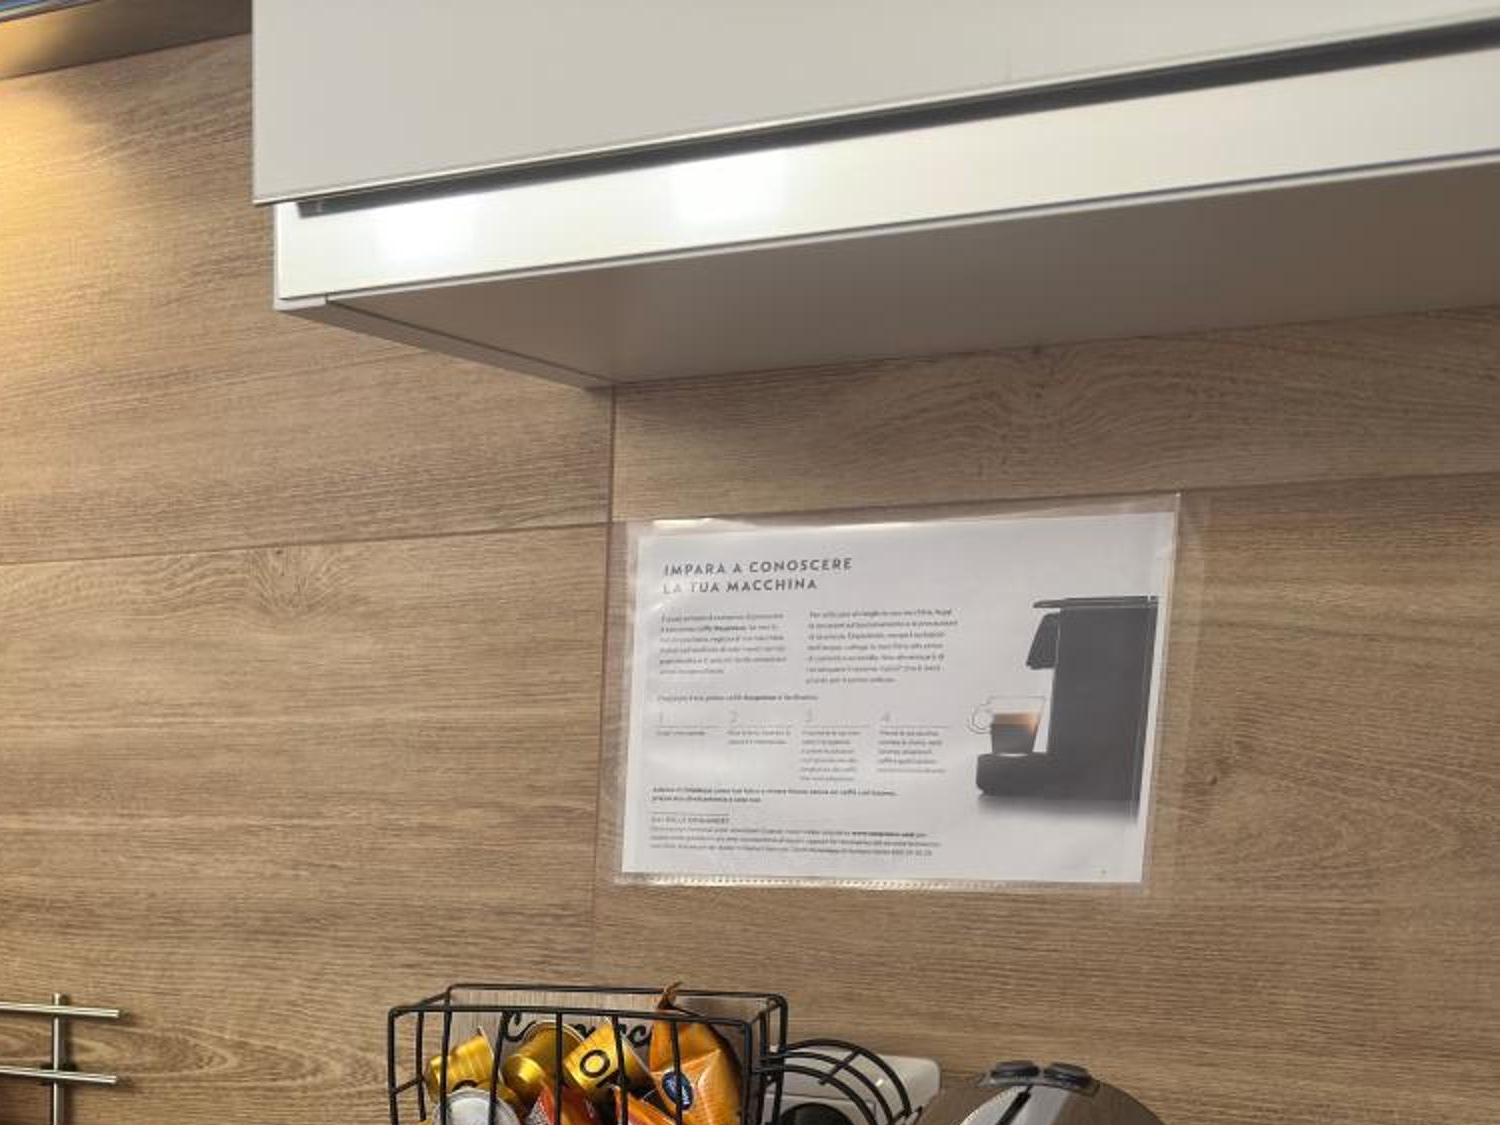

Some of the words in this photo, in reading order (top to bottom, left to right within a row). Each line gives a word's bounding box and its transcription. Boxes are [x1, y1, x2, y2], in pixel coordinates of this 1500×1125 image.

[664, 561, 726, 577] IMPARA
[731, 560, 743, 575] A
[749, 557, 853, 574] CONOSCERE
[663, 582, 683, 596] LA
[690, 581, 721, 594] TUA
[725, 578, 819, 593] MACCHINA
